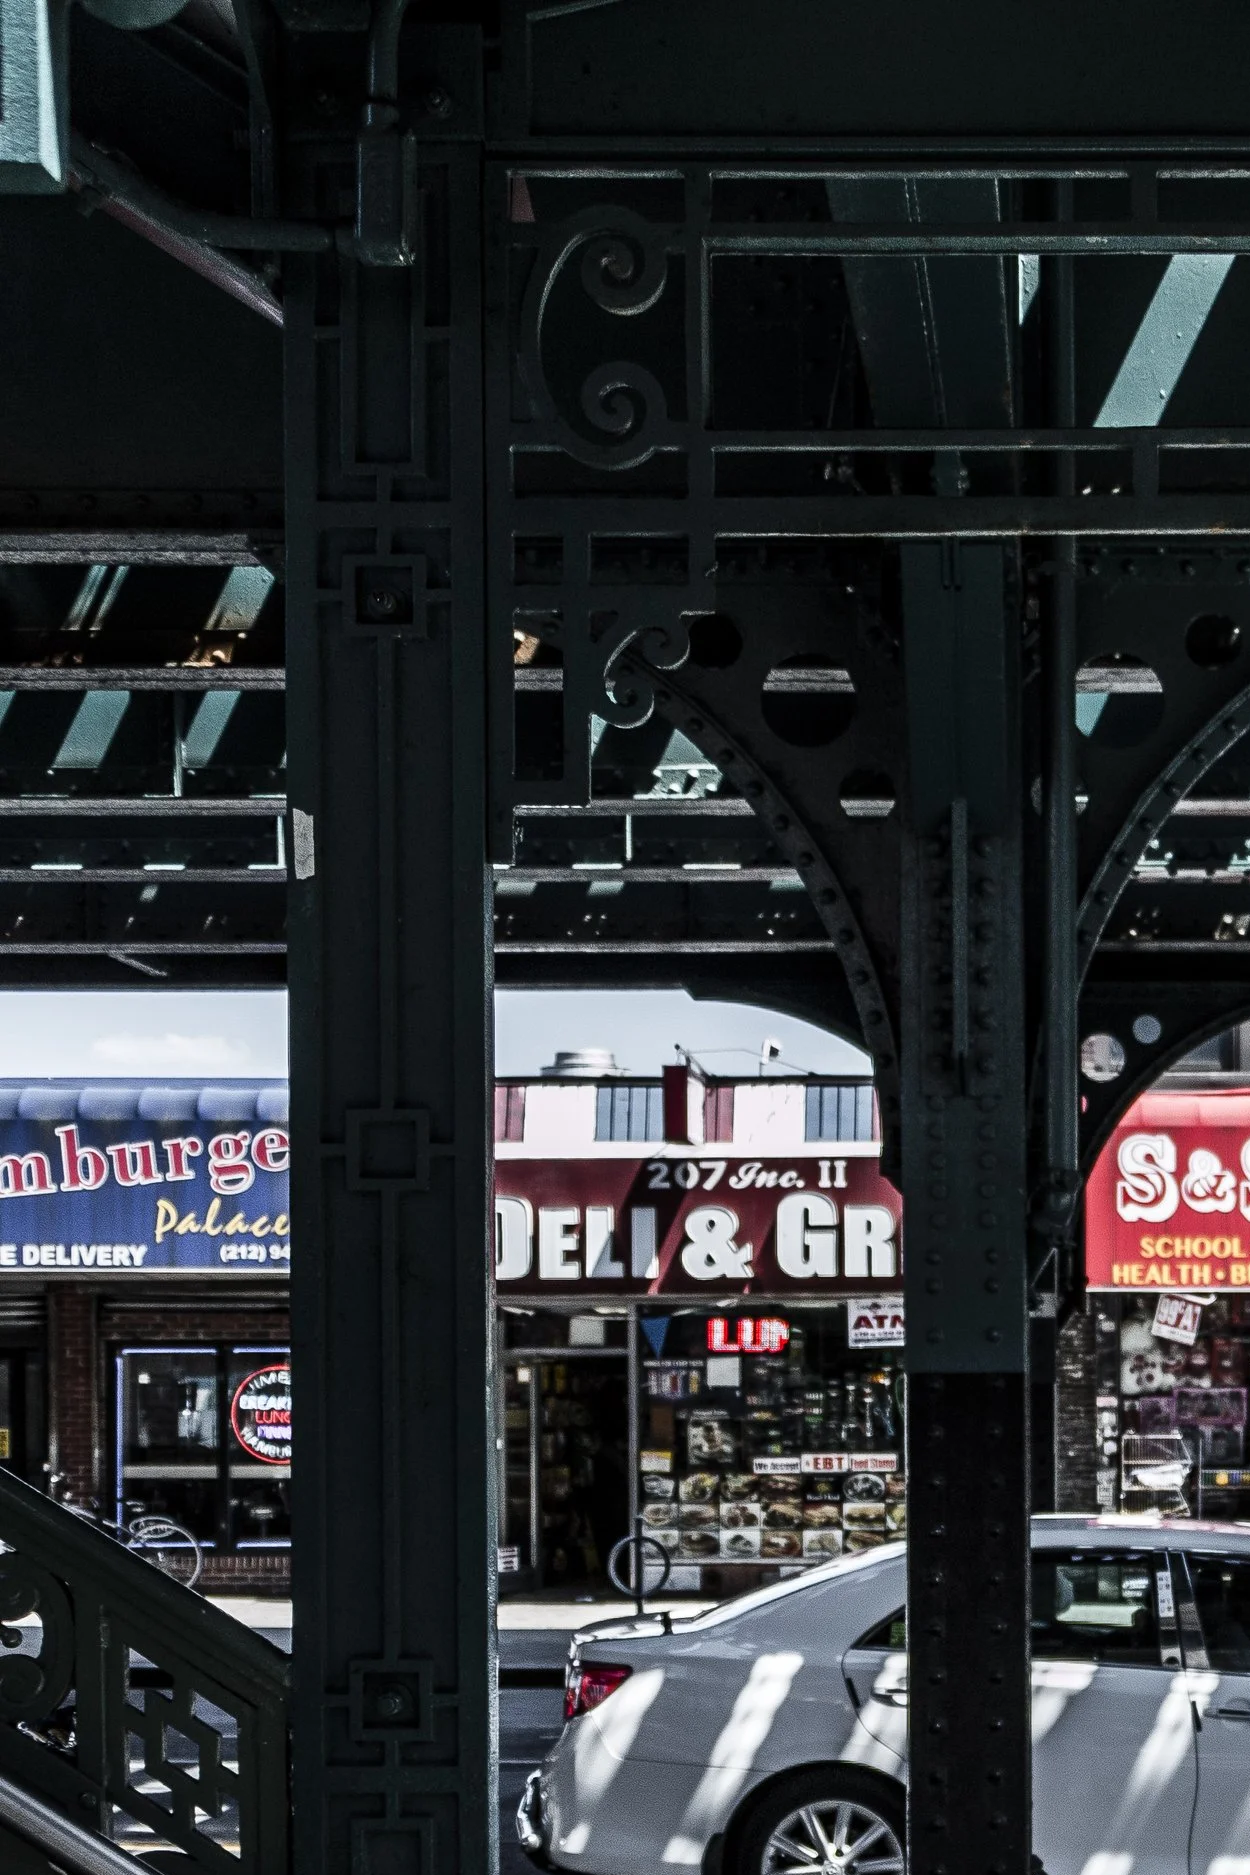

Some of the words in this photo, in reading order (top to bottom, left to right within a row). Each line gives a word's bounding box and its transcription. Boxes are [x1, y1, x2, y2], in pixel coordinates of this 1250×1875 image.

[647, 1161, 727, 1191] 207
[729, 1161, 805, 1190] Inc.
[818, 1160, 848, 1189] II
[155, 1197, 290, 1243] Palace
[681, 1205, 755, 1281] &
[776, 1191, 898, 1278] GR
[1140, 1235, 1246, 1259] SCHOOL
[22, 1244, 148, 1267] DELIVERY
[220, 1243, 267, 1263] (212)
[1113, 1263, 1212, 1286] HEALTH
[813, 1457, 844, 1470] EBT
